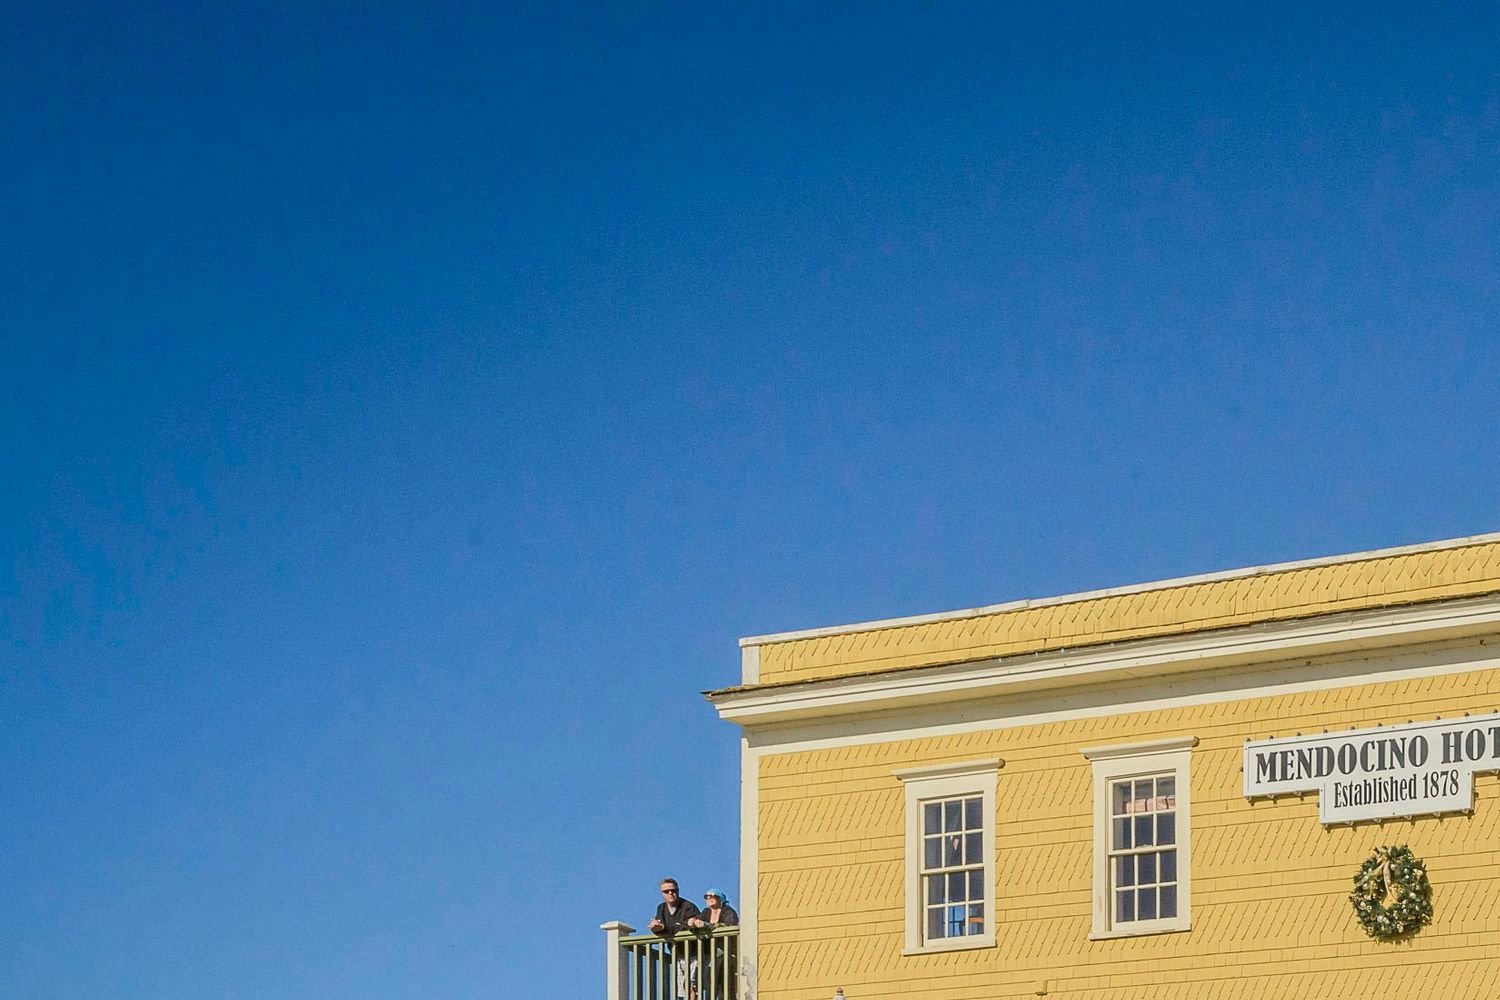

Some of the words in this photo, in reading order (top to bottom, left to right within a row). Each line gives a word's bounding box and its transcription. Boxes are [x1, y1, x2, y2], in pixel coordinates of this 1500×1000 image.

[1255, 735, 1429, 784] MENDOCINO
[1333, 773, 1417, 808] Established
[1422, 769, 1459, 799] 1878
